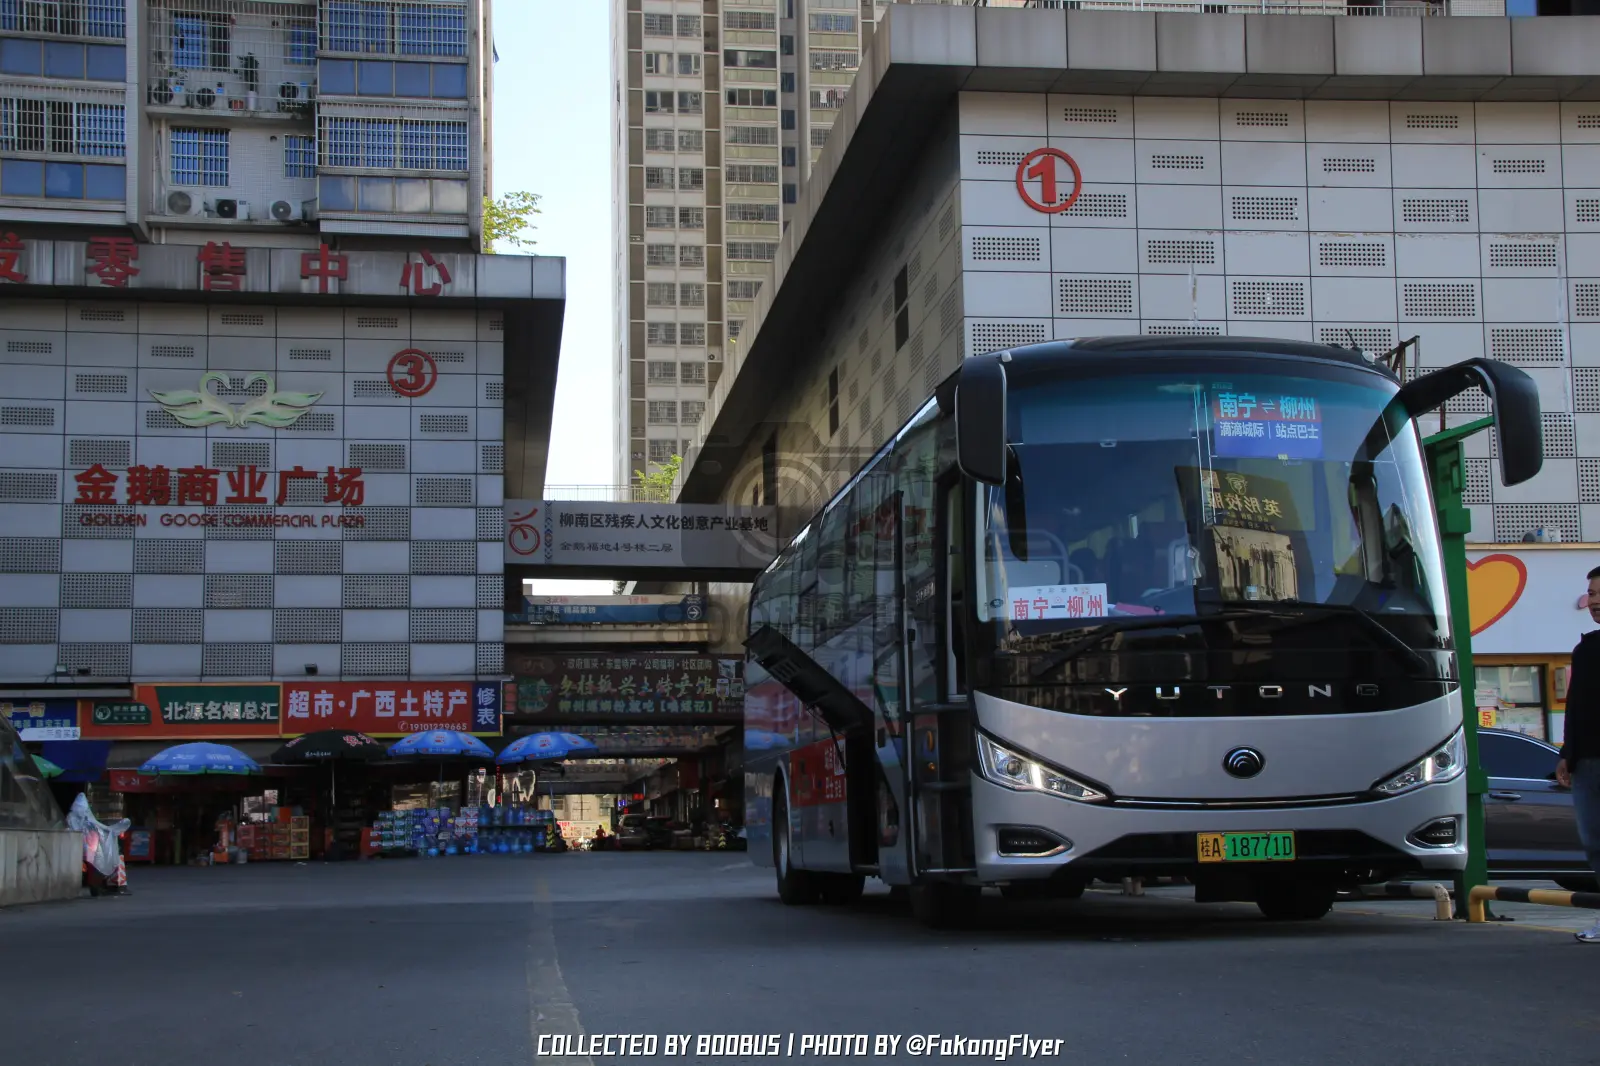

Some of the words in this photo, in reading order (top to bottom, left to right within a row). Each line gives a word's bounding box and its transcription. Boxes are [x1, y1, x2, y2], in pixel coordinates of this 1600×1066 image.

[1218, 392, 1257, 418] 南宁
[1279, 396, 1316, 420] 柳州
[1220, 421, 1264, 438] 滴滴城际
[1275, 423, 1319, 439] 站点巴士
[74, 463, 365, 506] 金鹅商业广场
[79, 513, 147, 528] GOLDEN
[160, 513, 218, 528] GOOSE
[223, 513, 318, 528] COMMERCIAL
[321, 513, 365, 528] PLAZA
[559, 512, 769, 532] 柳南区残疾人文化创意产业基地
[1104, 683, 1380, 700] YUTONG
[164, 701, 279, 721] 北源名烟总汇
[477, 687, 496, 725] 修表
[1200, 837, 1222, 858] 桂A
[1231, 836, 1292, 857] 18771D
